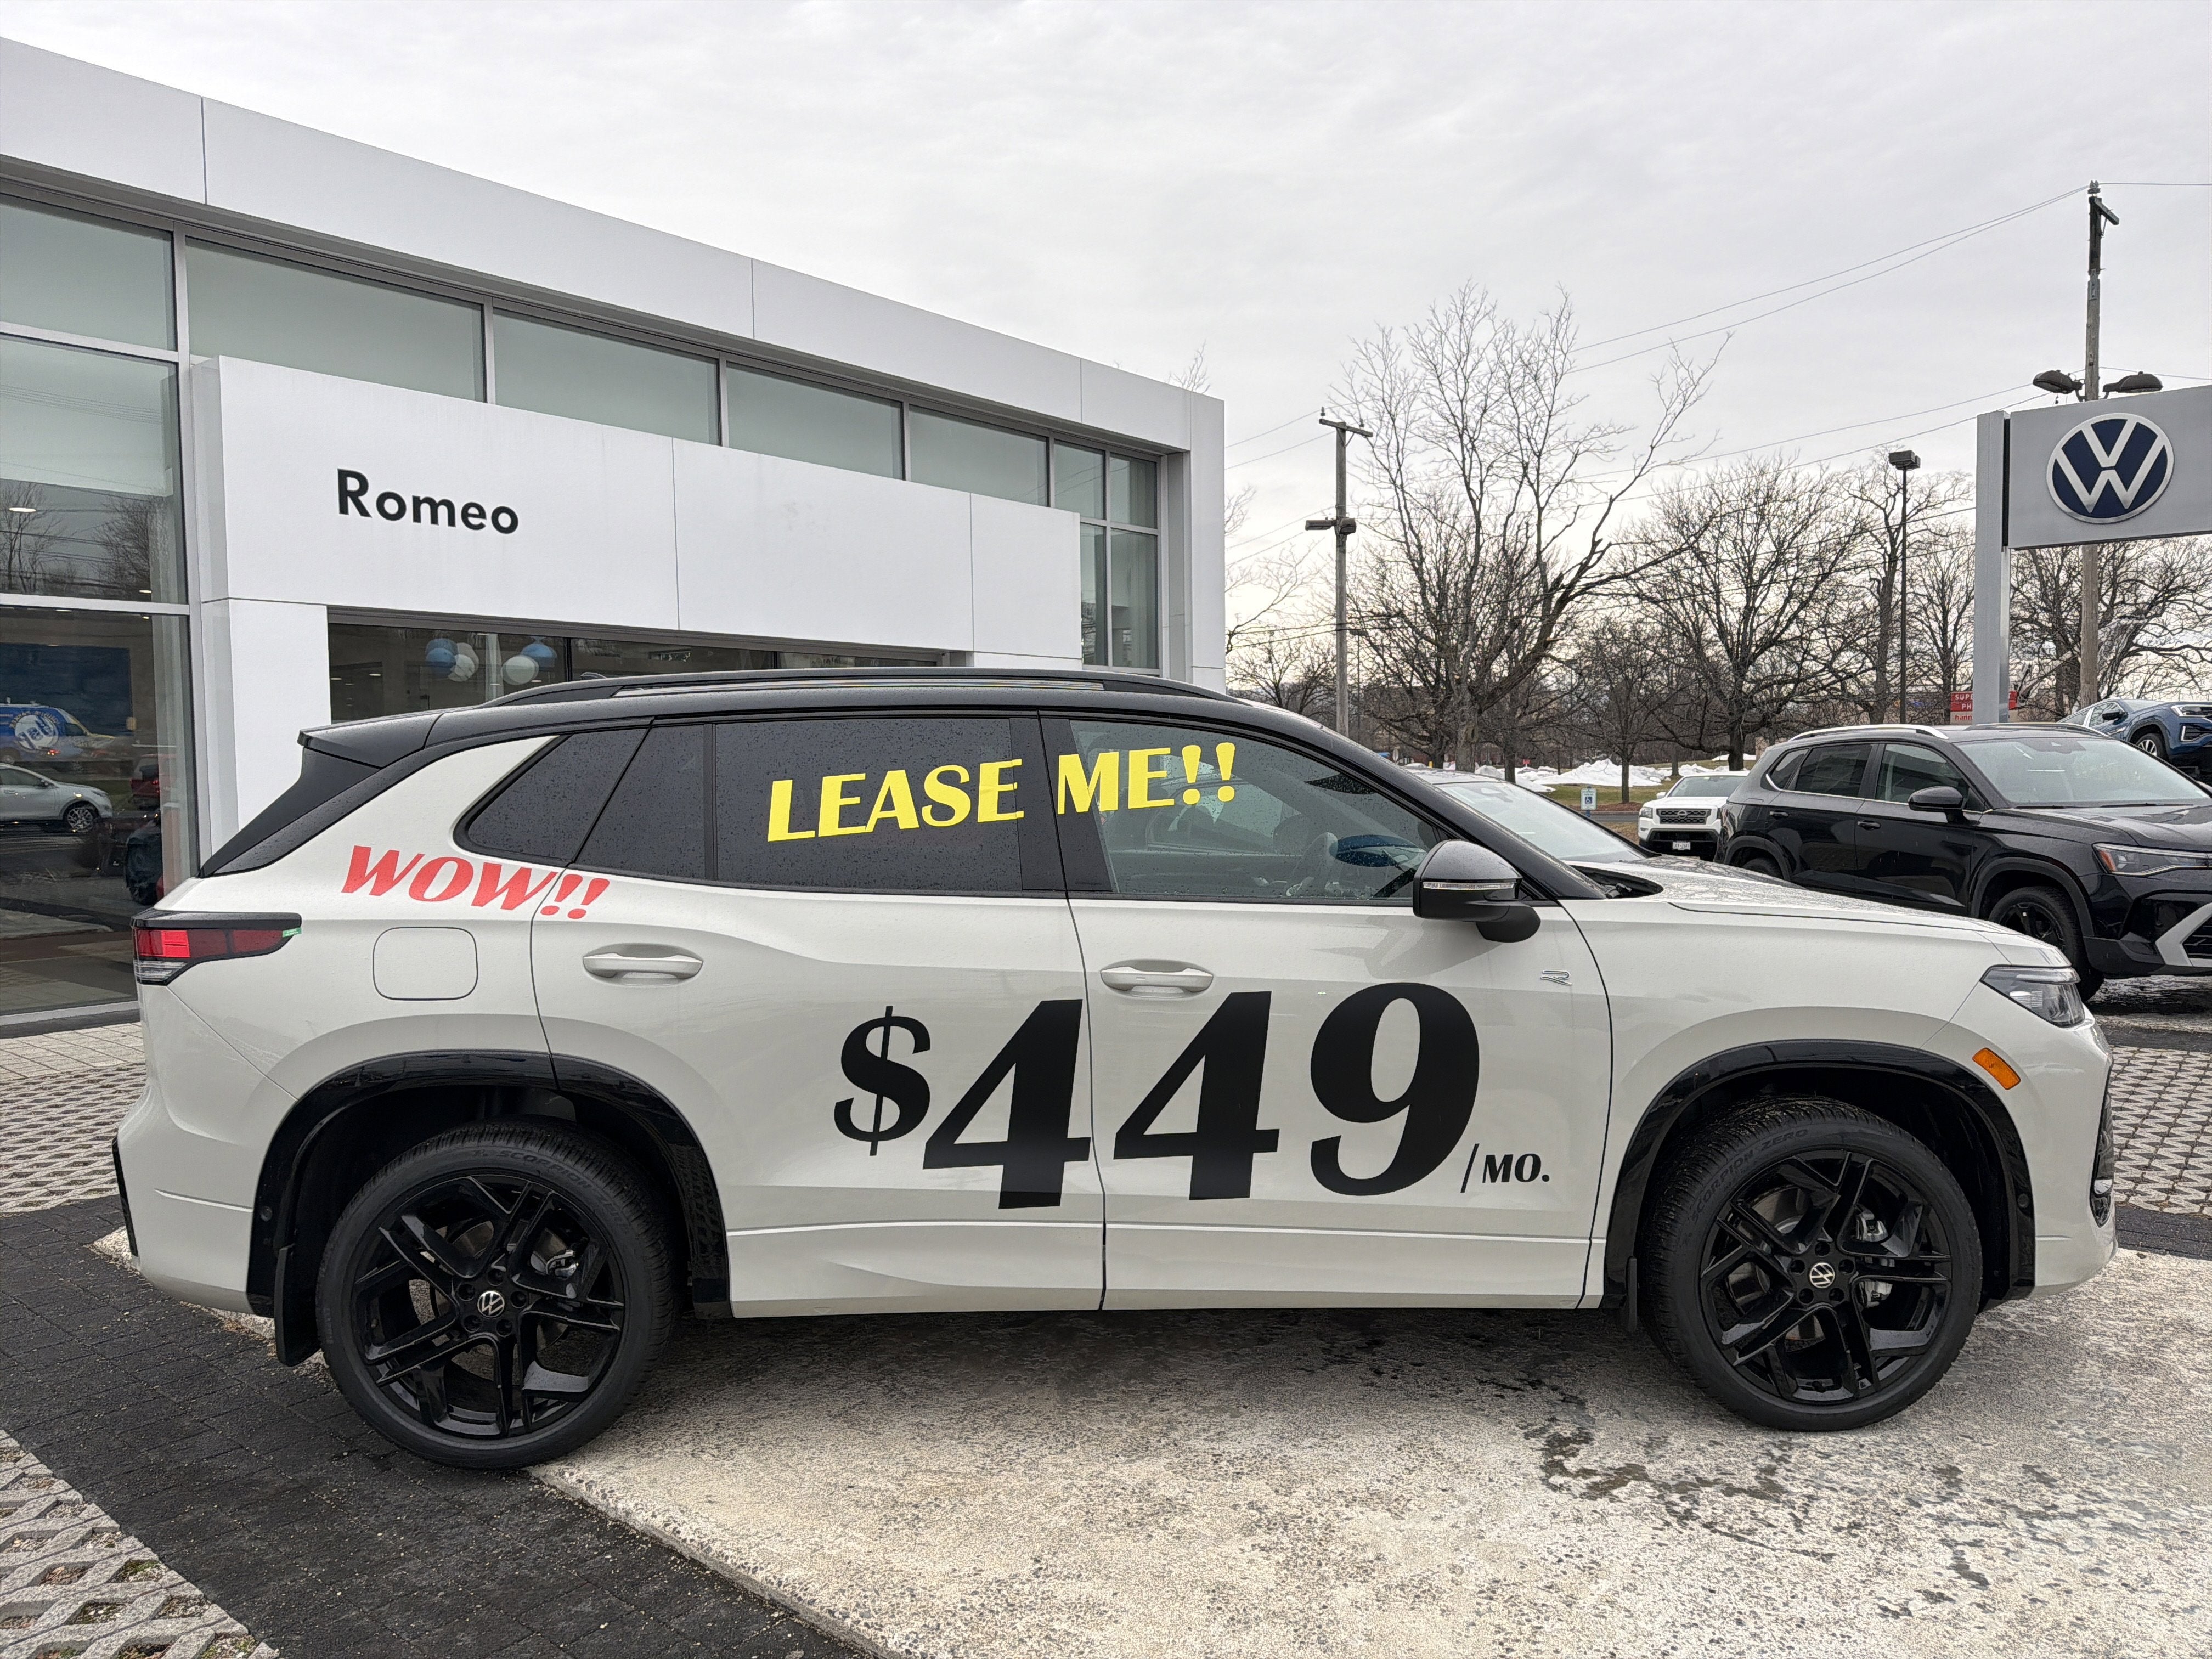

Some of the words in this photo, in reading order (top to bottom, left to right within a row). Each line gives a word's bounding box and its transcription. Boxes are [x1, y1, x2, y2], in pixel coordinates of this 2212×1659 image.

[337, 468, 518, 534] Romeo
[2046, 413, 2174, 524] VW
[767, 759, 1024, 842] LEASE
[1057, 742, 1236, 815] ME!!
[341, 845, 611, 919] WOW!!
[834, 981, 1480, 1210] $449
[496, 1150, 592, 1188] SCORPION
[1760, 1129, 1808, 1151] ZERO
